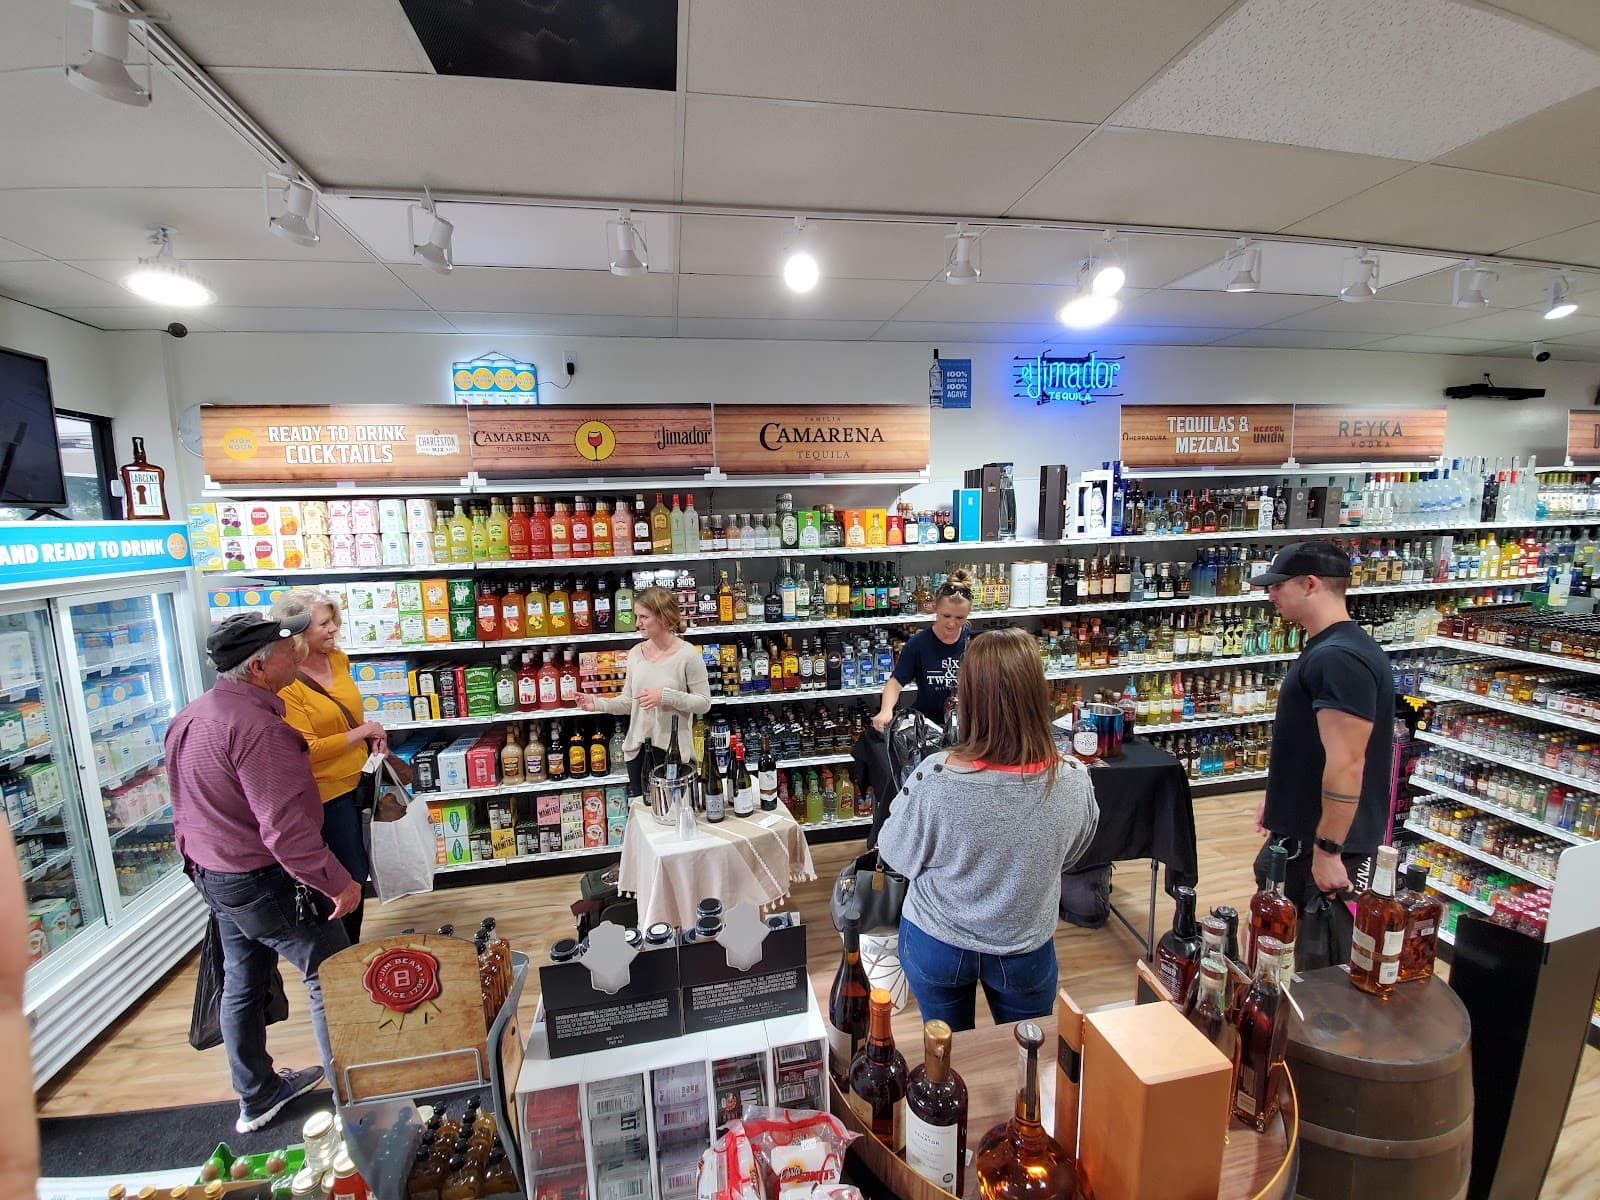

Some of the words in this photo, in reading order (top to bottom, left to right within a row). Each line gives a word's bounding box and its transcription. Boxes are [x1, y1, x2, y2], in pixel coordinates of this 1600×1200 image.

[1027, 352, 1121, 399] Jimador
[1048, 391, 1092, 401] TEQUILA
[268, 426, 322, 442] READY
[327, 425, 350, 441] TO
[355, 424, 407, 441] DRINK
[1167, 416, 1235, 433] TEQUILAS
[1239, 416, 1249, 432] &
[1338, 421, 1404, 438] REYKA
[418, 436, 457, 447] CHARLESTON
[473, 430, 551, 447] CAMARENA
[657, 425, 711, 450] Jimador
[759, 422, 885, 451] CAMARENA
[1175, 436, 1240, 454] MEZCALS
[1351, 440, 1391, 448] VODKA
[285, 444, 393, 464] COCKTAILS
[796, 450, 851, 460] TEQUILA
[131, 473, 158, 483] LARCENY
[0, 543, 39, 566] AND
[41, 541, 97, 563] READY
[100, 540, 121, 559] TO
[121, 538, 166, 557] DRINK
[676, 577, 696, 587] SHOTS
[698, 602, 717, 613] SHOTS
[941, 657, 960, 669] SIX
[945, 666, 957, 679] &
[380, 962, 392, 977] JIM
[395, 958, 422, 972] BEAM
[380, 983, 407, 998] SINCE
